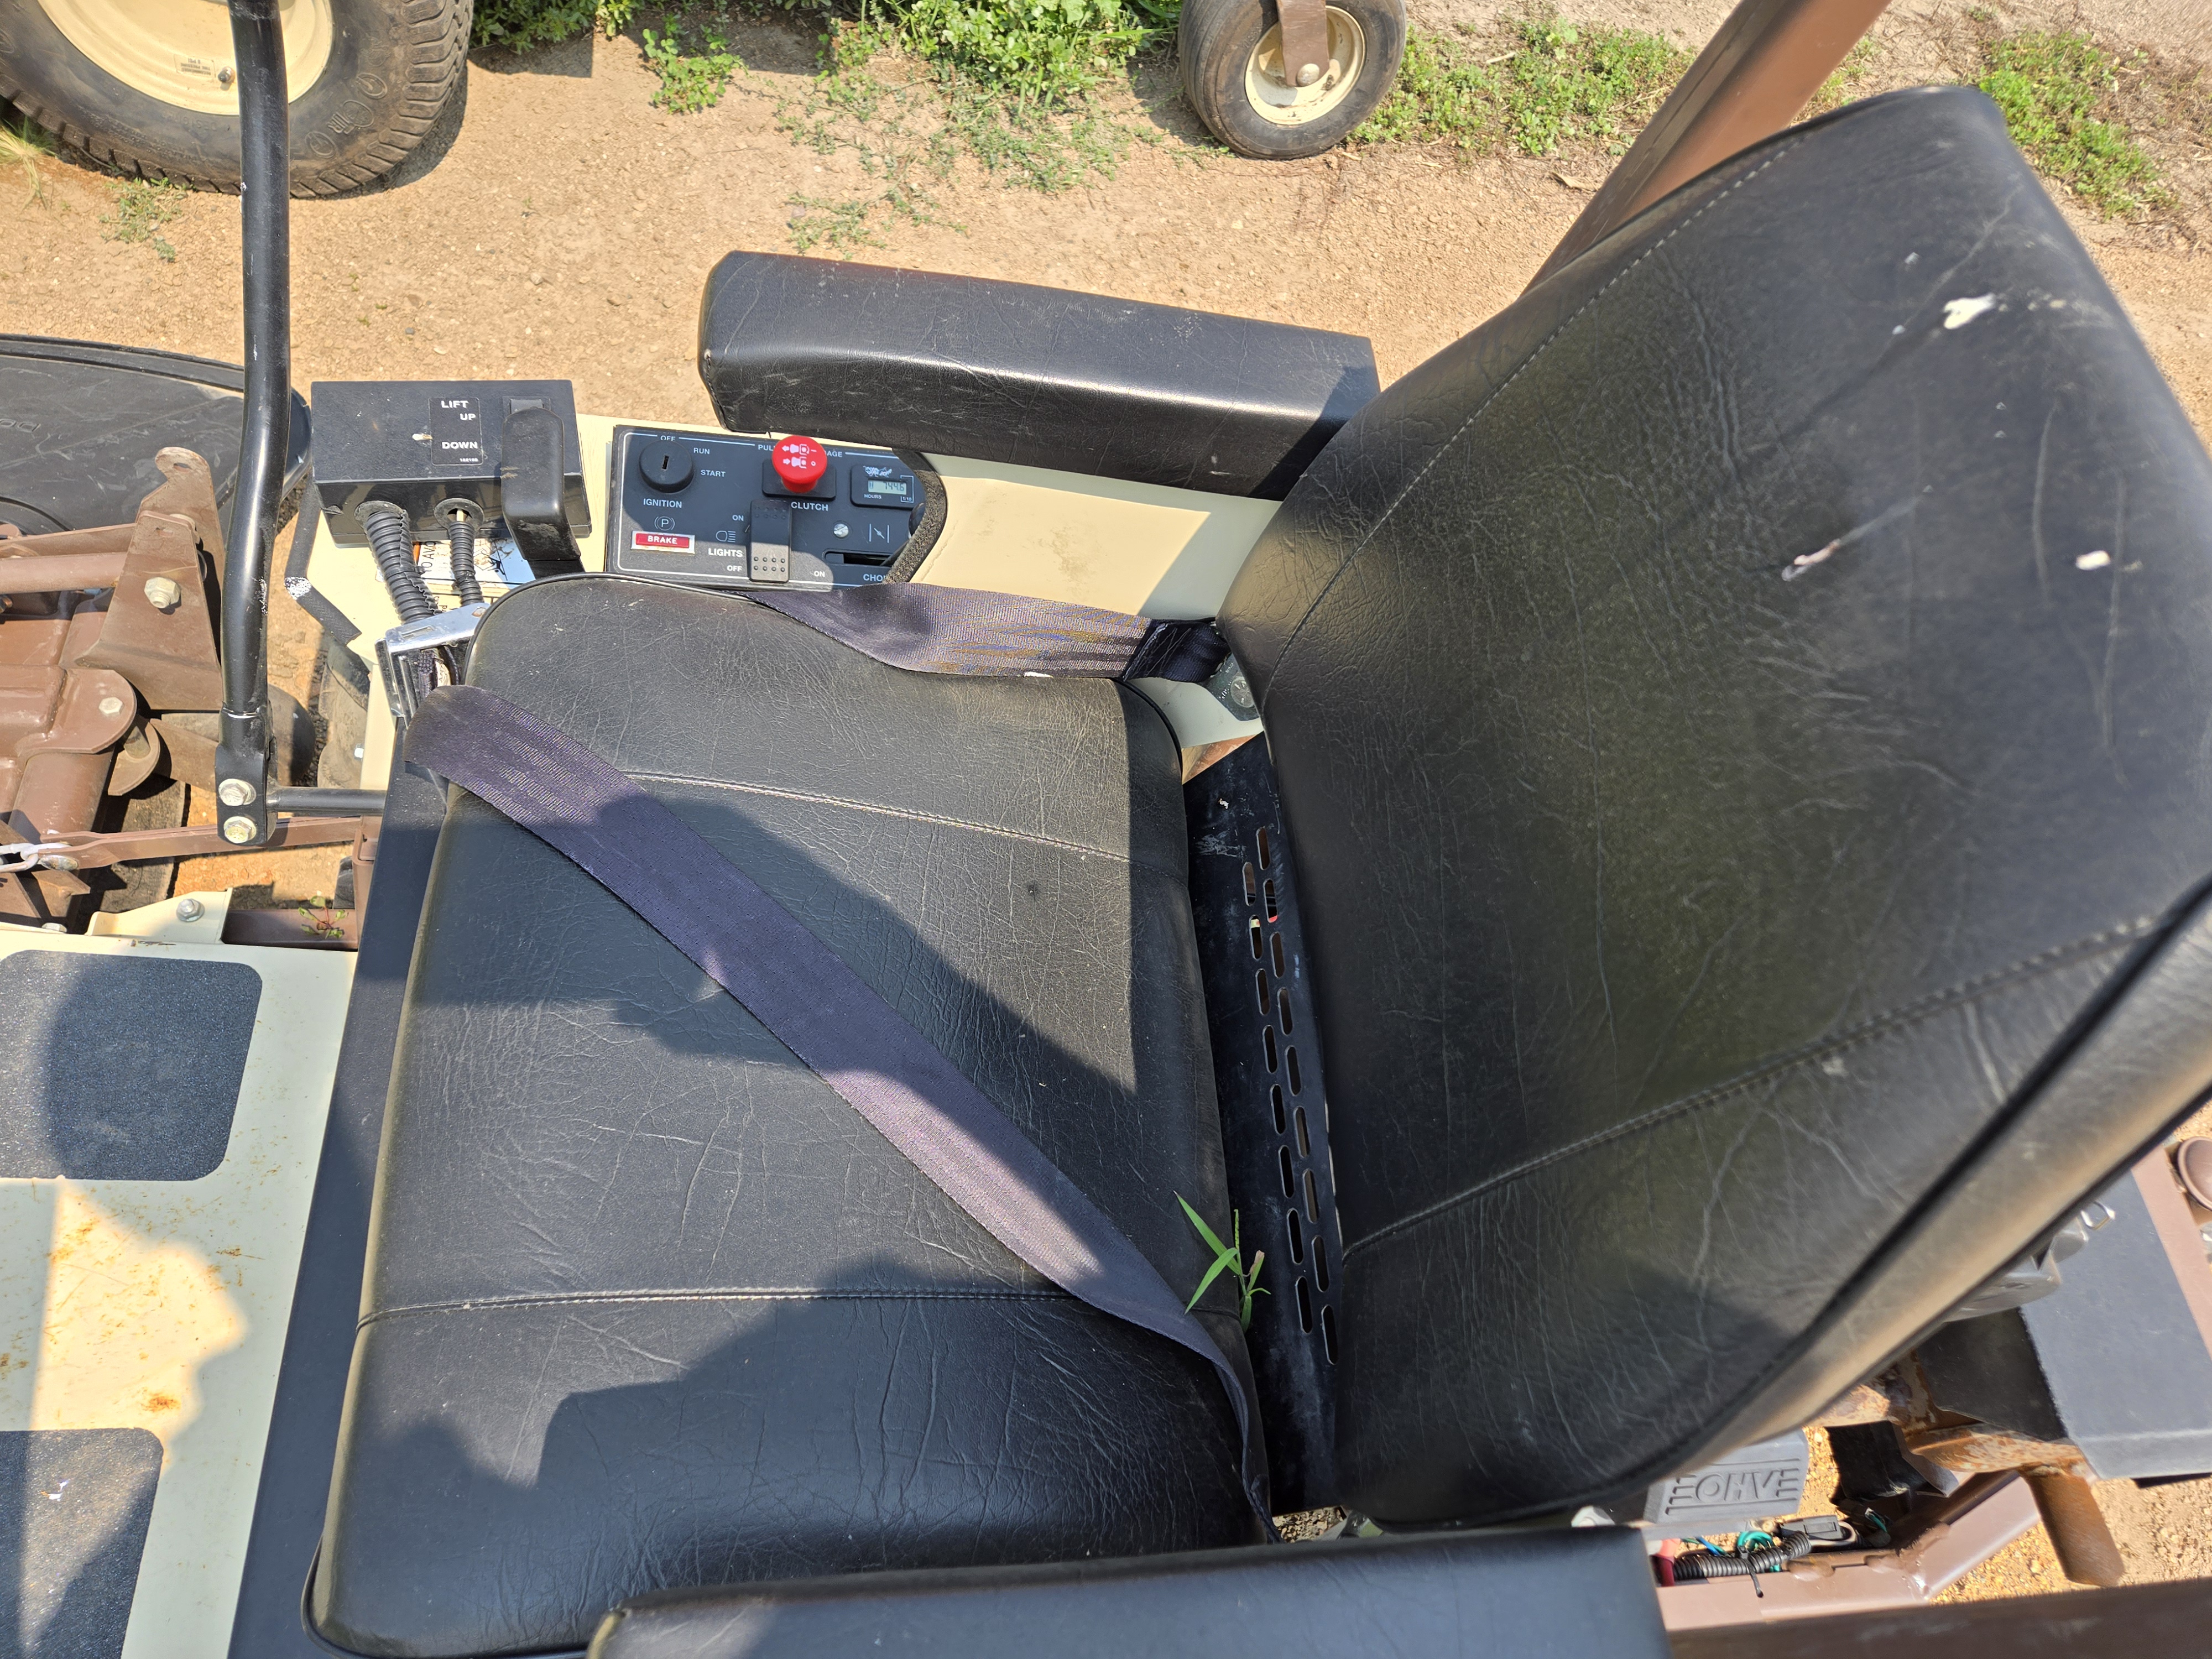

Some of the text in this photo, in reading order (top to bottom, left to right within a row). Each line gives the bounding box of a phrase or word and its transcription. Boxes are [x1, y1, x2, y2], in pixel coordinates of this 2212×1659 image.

[701, 469, 726, 477] START
[643, 498, 682, 508] IGNITION
[791, 502, 828, 512] CLUTCH
[647, 535, 678, 545] BRAKE
[708, 547, 744, 558] LIGHTS
[863, 573, 887, 582] CHO
